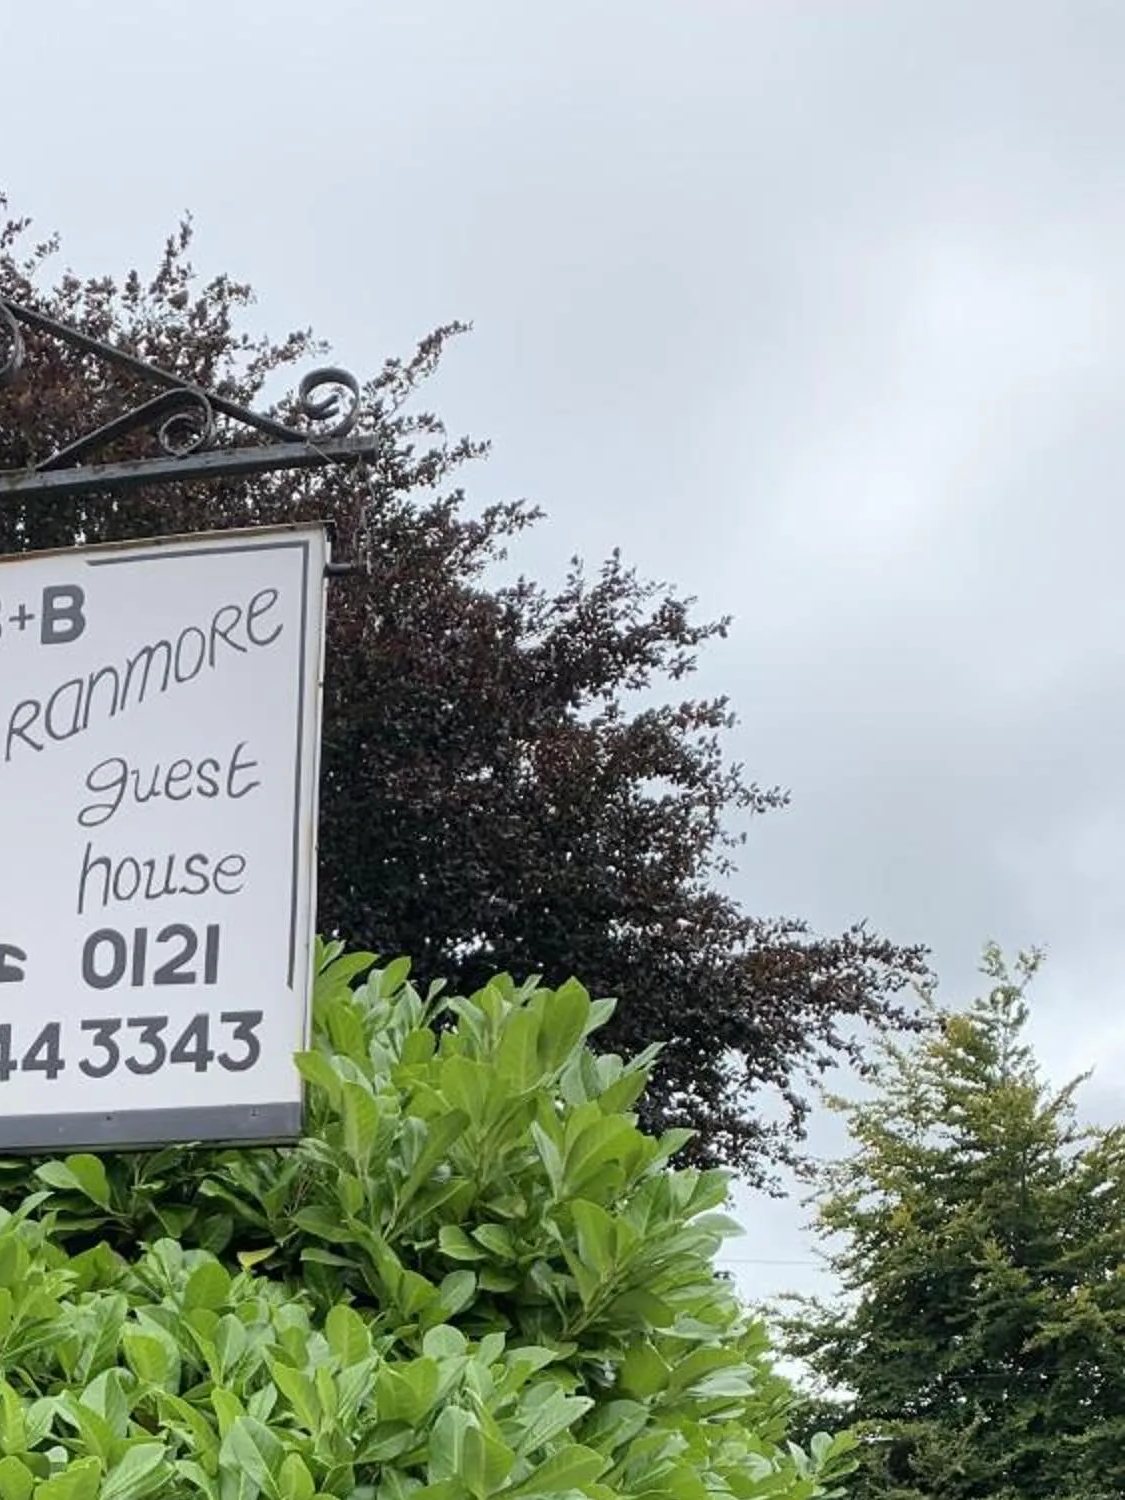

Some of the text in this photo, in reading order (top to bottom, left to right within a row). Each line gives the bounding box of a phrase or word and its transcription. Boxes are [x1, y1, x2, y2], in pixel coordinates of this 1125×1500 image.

[77, 743, 261, 827] guest
[77, 842, 246, 915] house
[82, 923, 220, 990] 0121
